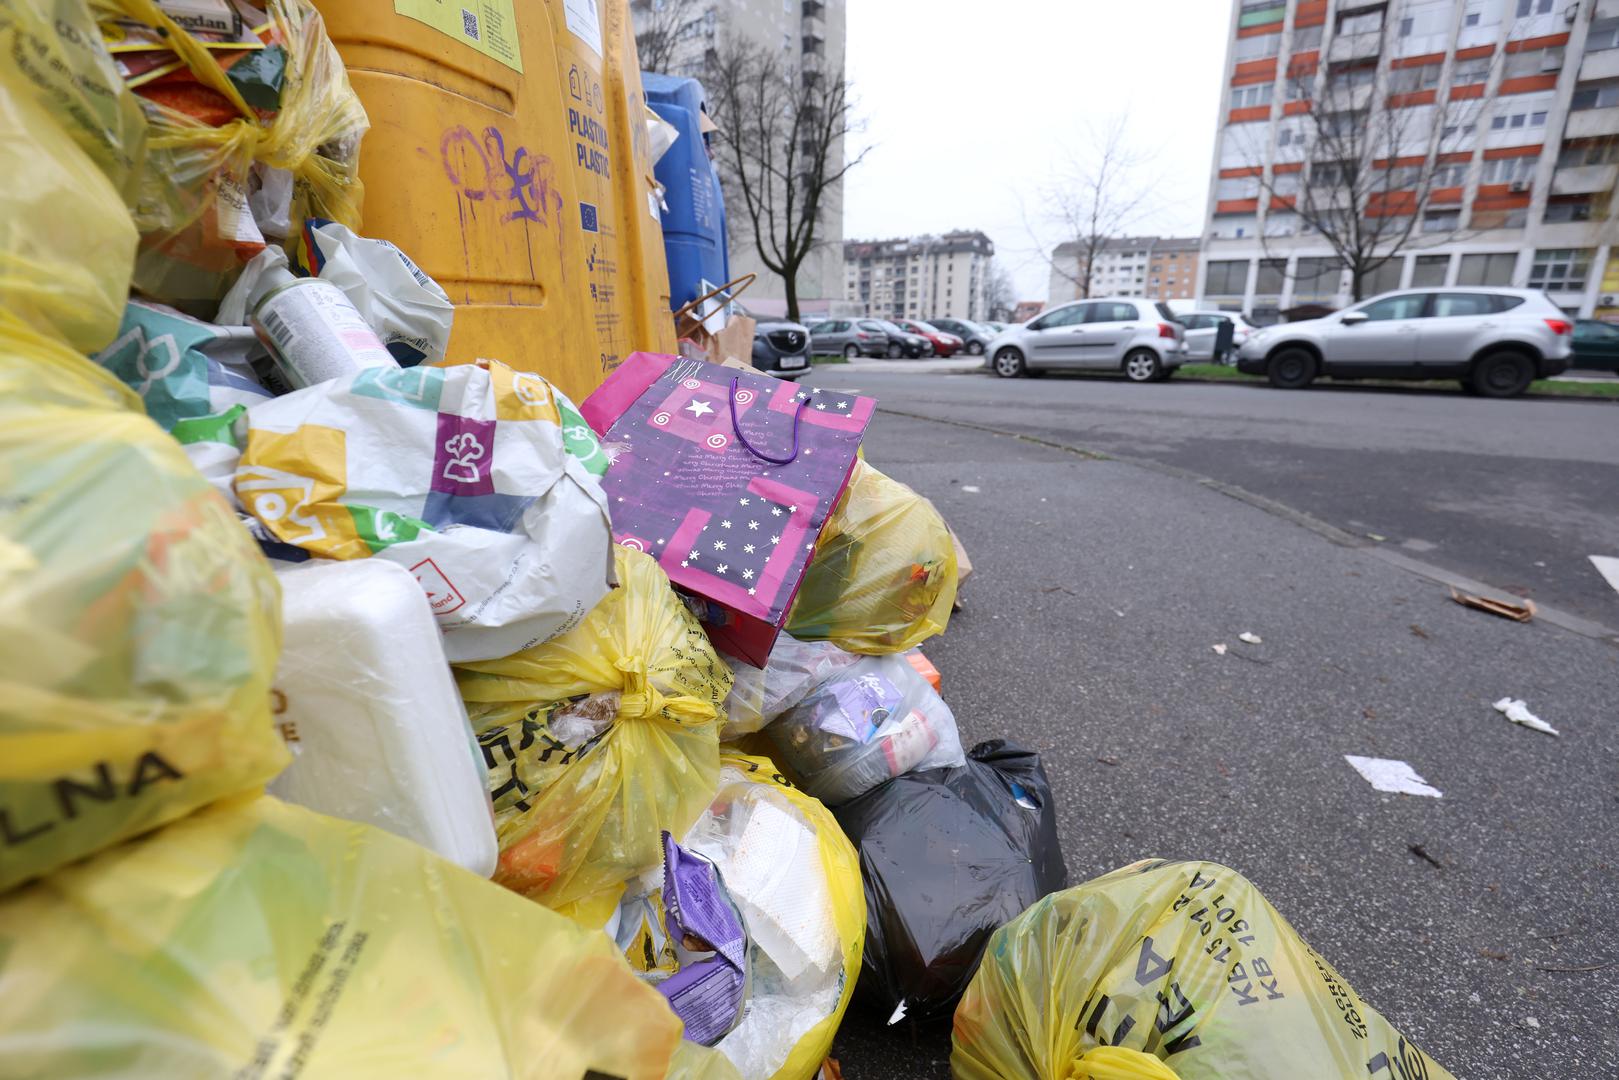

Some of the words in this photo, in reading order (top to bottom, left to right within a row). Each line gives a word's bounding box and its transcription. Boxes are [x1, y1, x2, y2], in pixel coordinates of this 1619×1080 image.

[569, 107, 609, 151] PLASTIKA
[577, 142, 610, 180] PLASTIC
[1212, 893, 1256, 947] 1501
[1251, 956, 1285, 1001] KB
